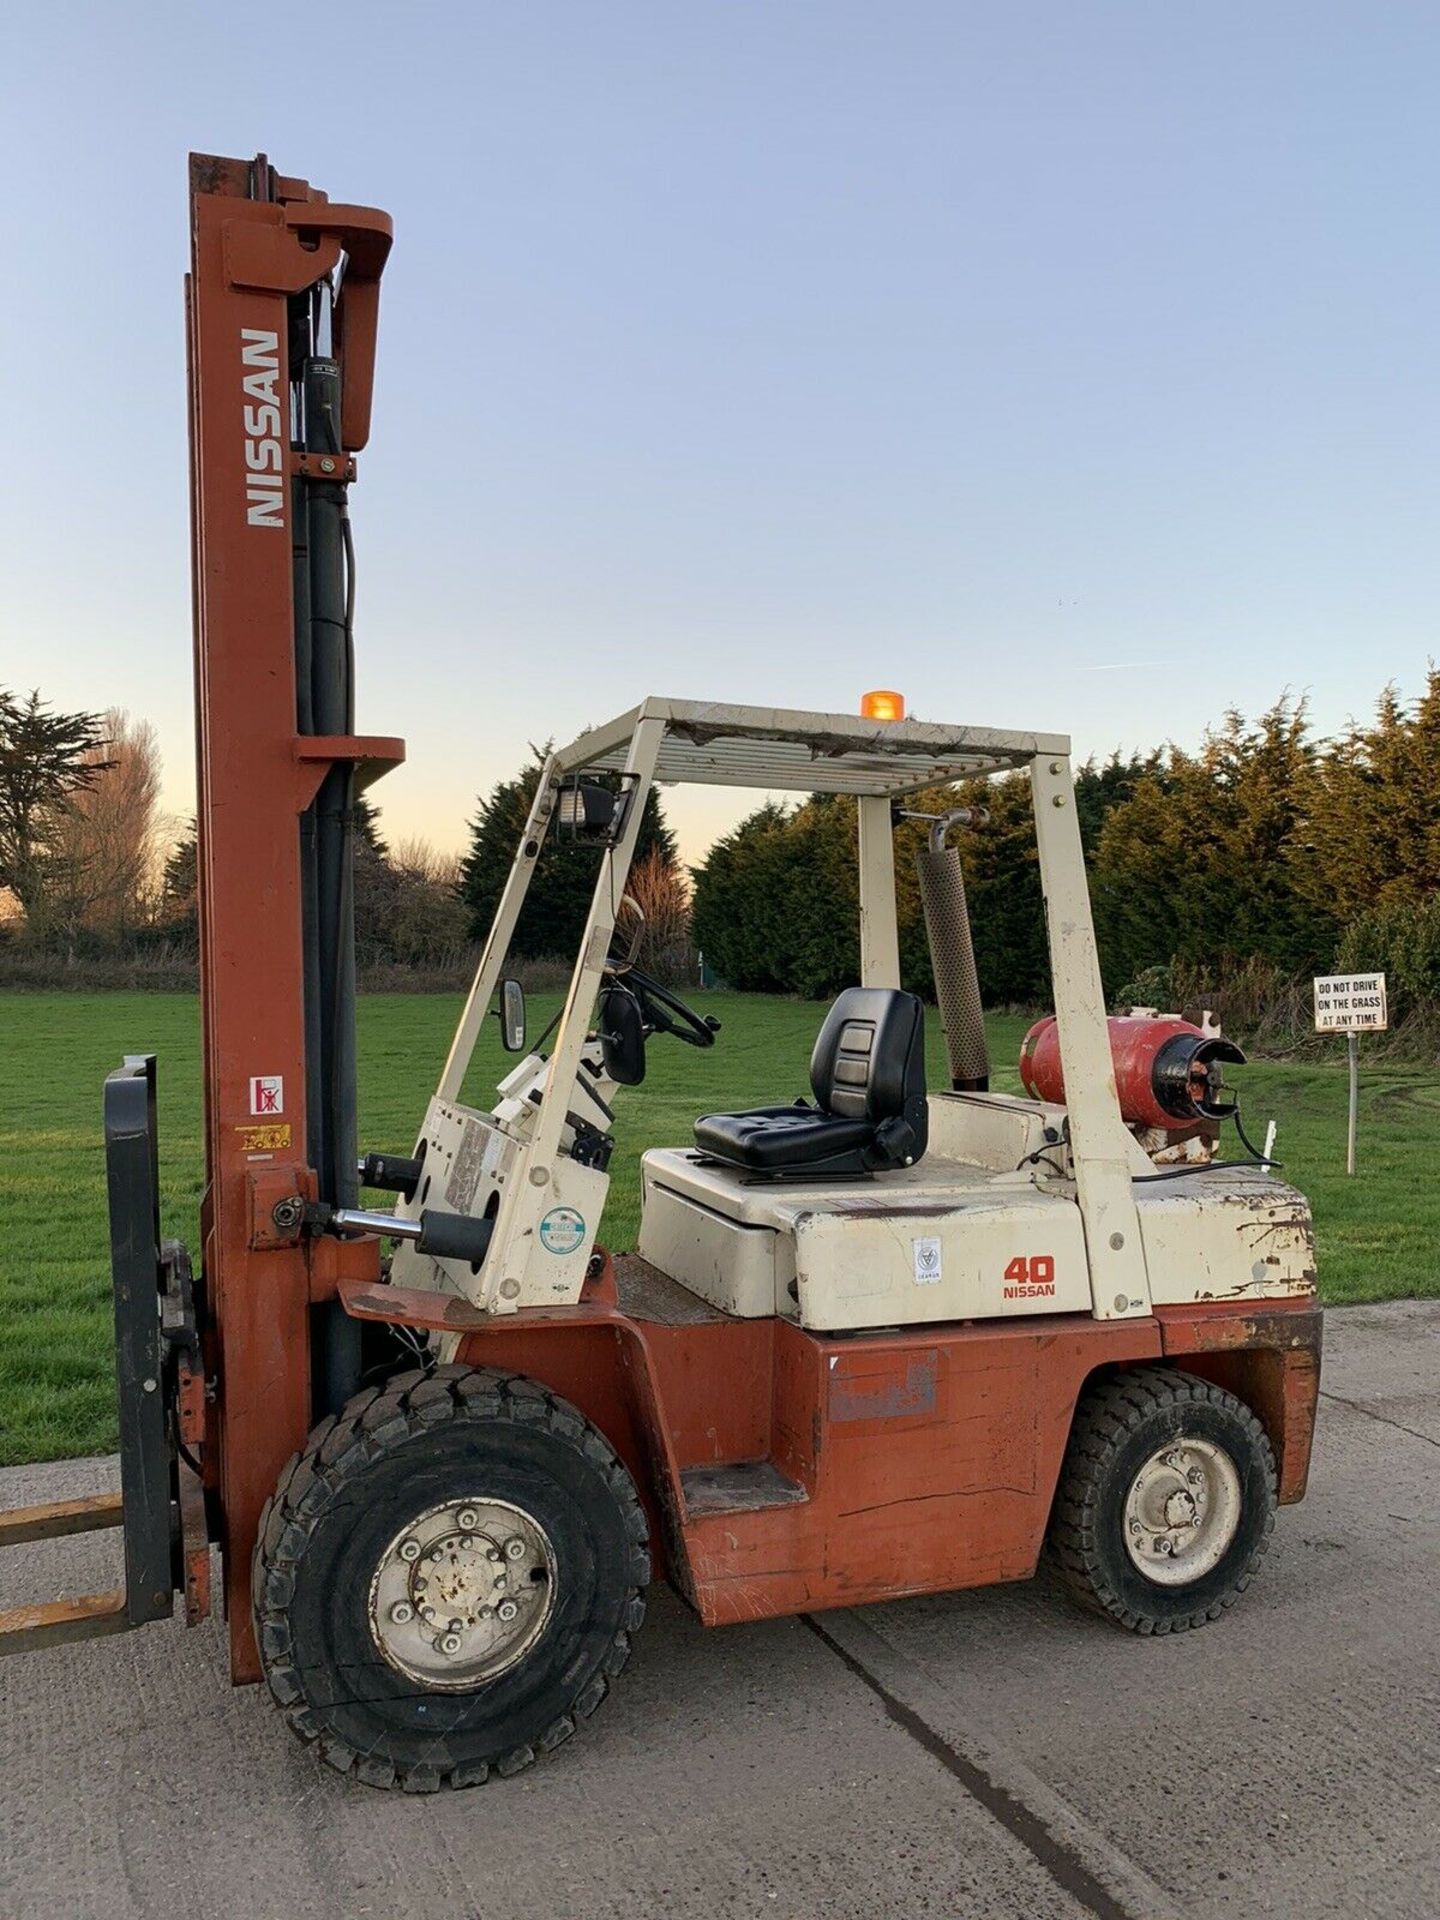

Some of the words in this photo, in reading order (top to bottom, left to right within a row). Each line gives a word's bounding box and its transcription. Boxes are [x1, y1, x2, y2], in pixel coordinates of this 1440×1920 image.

[241, 328, 284, 528] NISSAN
[1319, 983, 1331, 994] DO
[1333, 982, 1350, 993] NOT
[1353, 980, 1378, 992] DRIVE
[1318, 1000, 1330, 1011] ON
[1333, 999, 1349, 1010] THE
[1352, 996, 1381, 1009] GRASS
[1322, 1015, 1333, 1026] AT
[1336, 1015, 1353, 1026] ANY
[1355, 1013, 1377, 1025] TIME
[1004, 1255, 1055, 1284] 40
[1003, 1284, 1055, 1299] NISSAN
